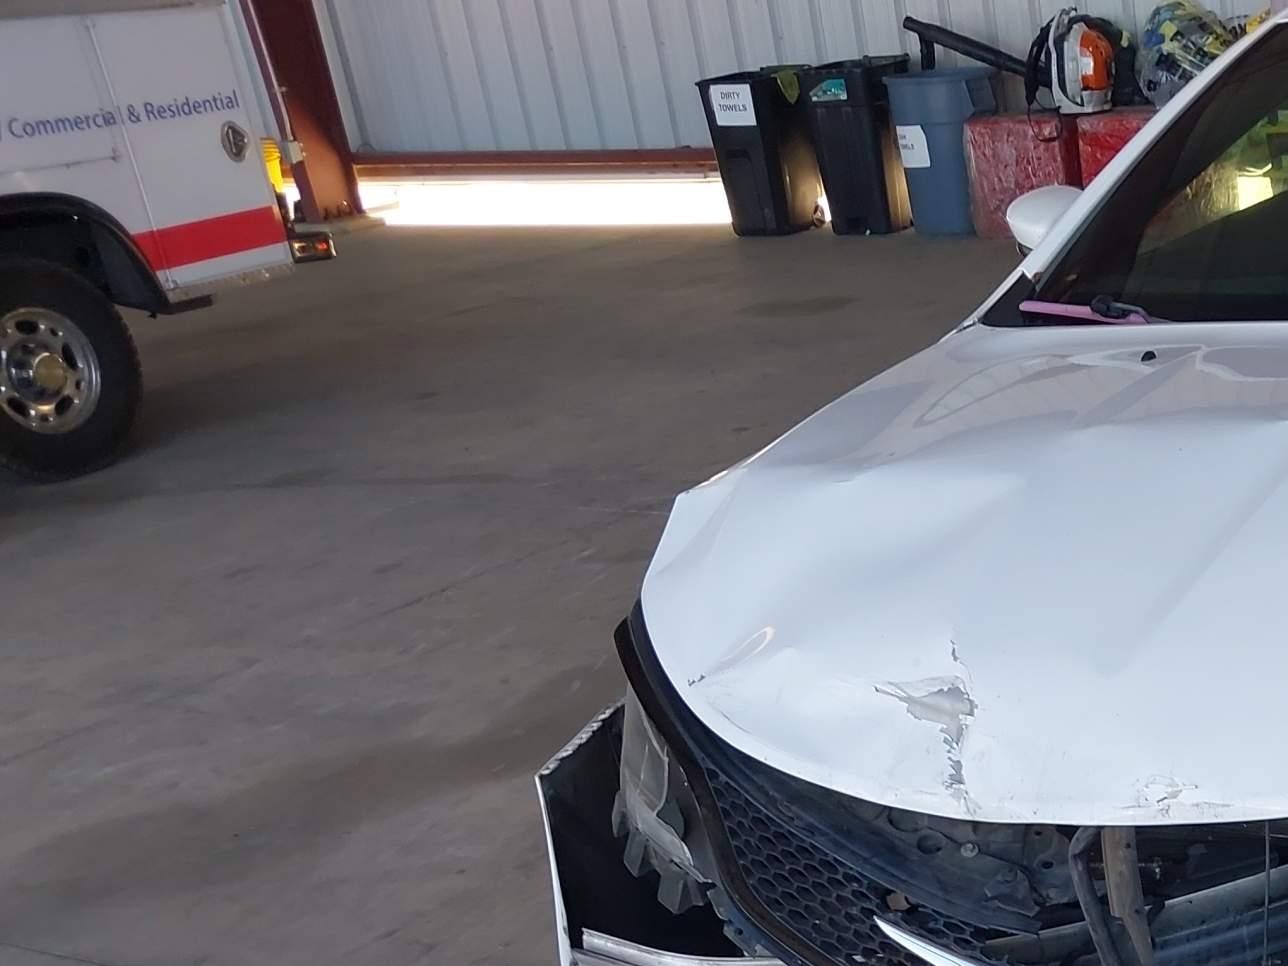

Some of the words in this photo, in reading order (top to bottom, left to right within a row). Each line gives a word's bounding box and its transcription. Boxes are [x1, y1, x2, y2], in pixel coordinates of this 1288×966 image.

[720, 91, 740, 100] DIRTY
[718, 103, 747, 112] TOWELS
[8, 106, 125, 138] Commercial
[127, 104, 142, 124] &
[144, 90, 241, 120] Residential
